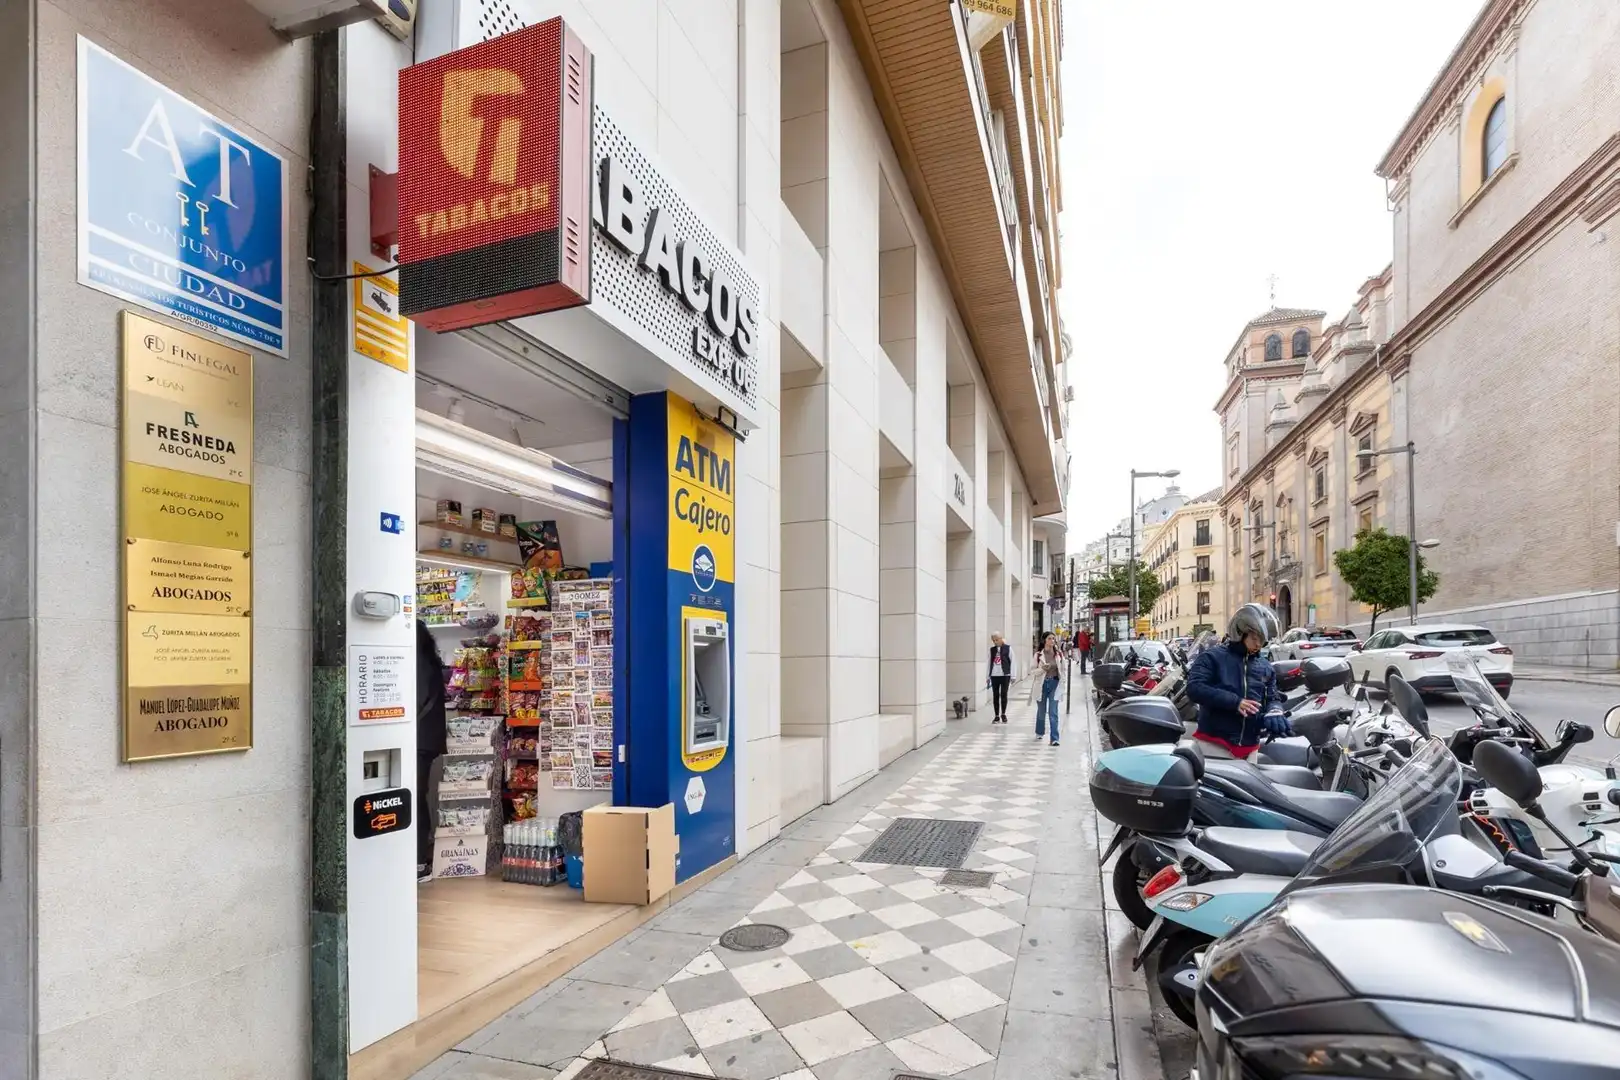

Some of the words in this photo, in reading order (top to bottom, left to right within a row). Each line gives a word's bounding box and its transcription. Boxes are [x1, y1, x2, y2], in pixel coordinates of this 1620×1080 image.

[977, 1, 994, 11] 964
[996, 5, 1013, 16] 686
[414, 182, 550, 240] TABACOS
[127, 211, 246, 273] CONJUNTO
[593, 156, 759, 358] BACOS
[129, 253, 246, 311] CIUDAD
[170, 310, 219, 333] A/GR/00352
[177, 300, 230, 326] TURÍSTICOS
[172, 345, 240, 376] FINLEGAL
[146, 422, 237, 454] FRESNEDA
[158, 443, 226, 465] ABOGADOS
[675, 434, 731, 496] ATM
[159, 504, 224, 521] ABOGADO
[674, 487, 731, 536] Cajero
[150, 570, 177, 578] Ismael
[151, 556, 181, 565] Alfonso
[183, 559, 202, 567] Luna
[203, 561, 232, 571] Rodrigo
[151, 586, 232, 603] ABOGADOS
[574, 592, 600, 600] GOMEZ
[358, 655, 368, 704] HORARIO
[139, 699, 165, 715] MANUEL
[154, 716, 228, 732] ABOGADO
